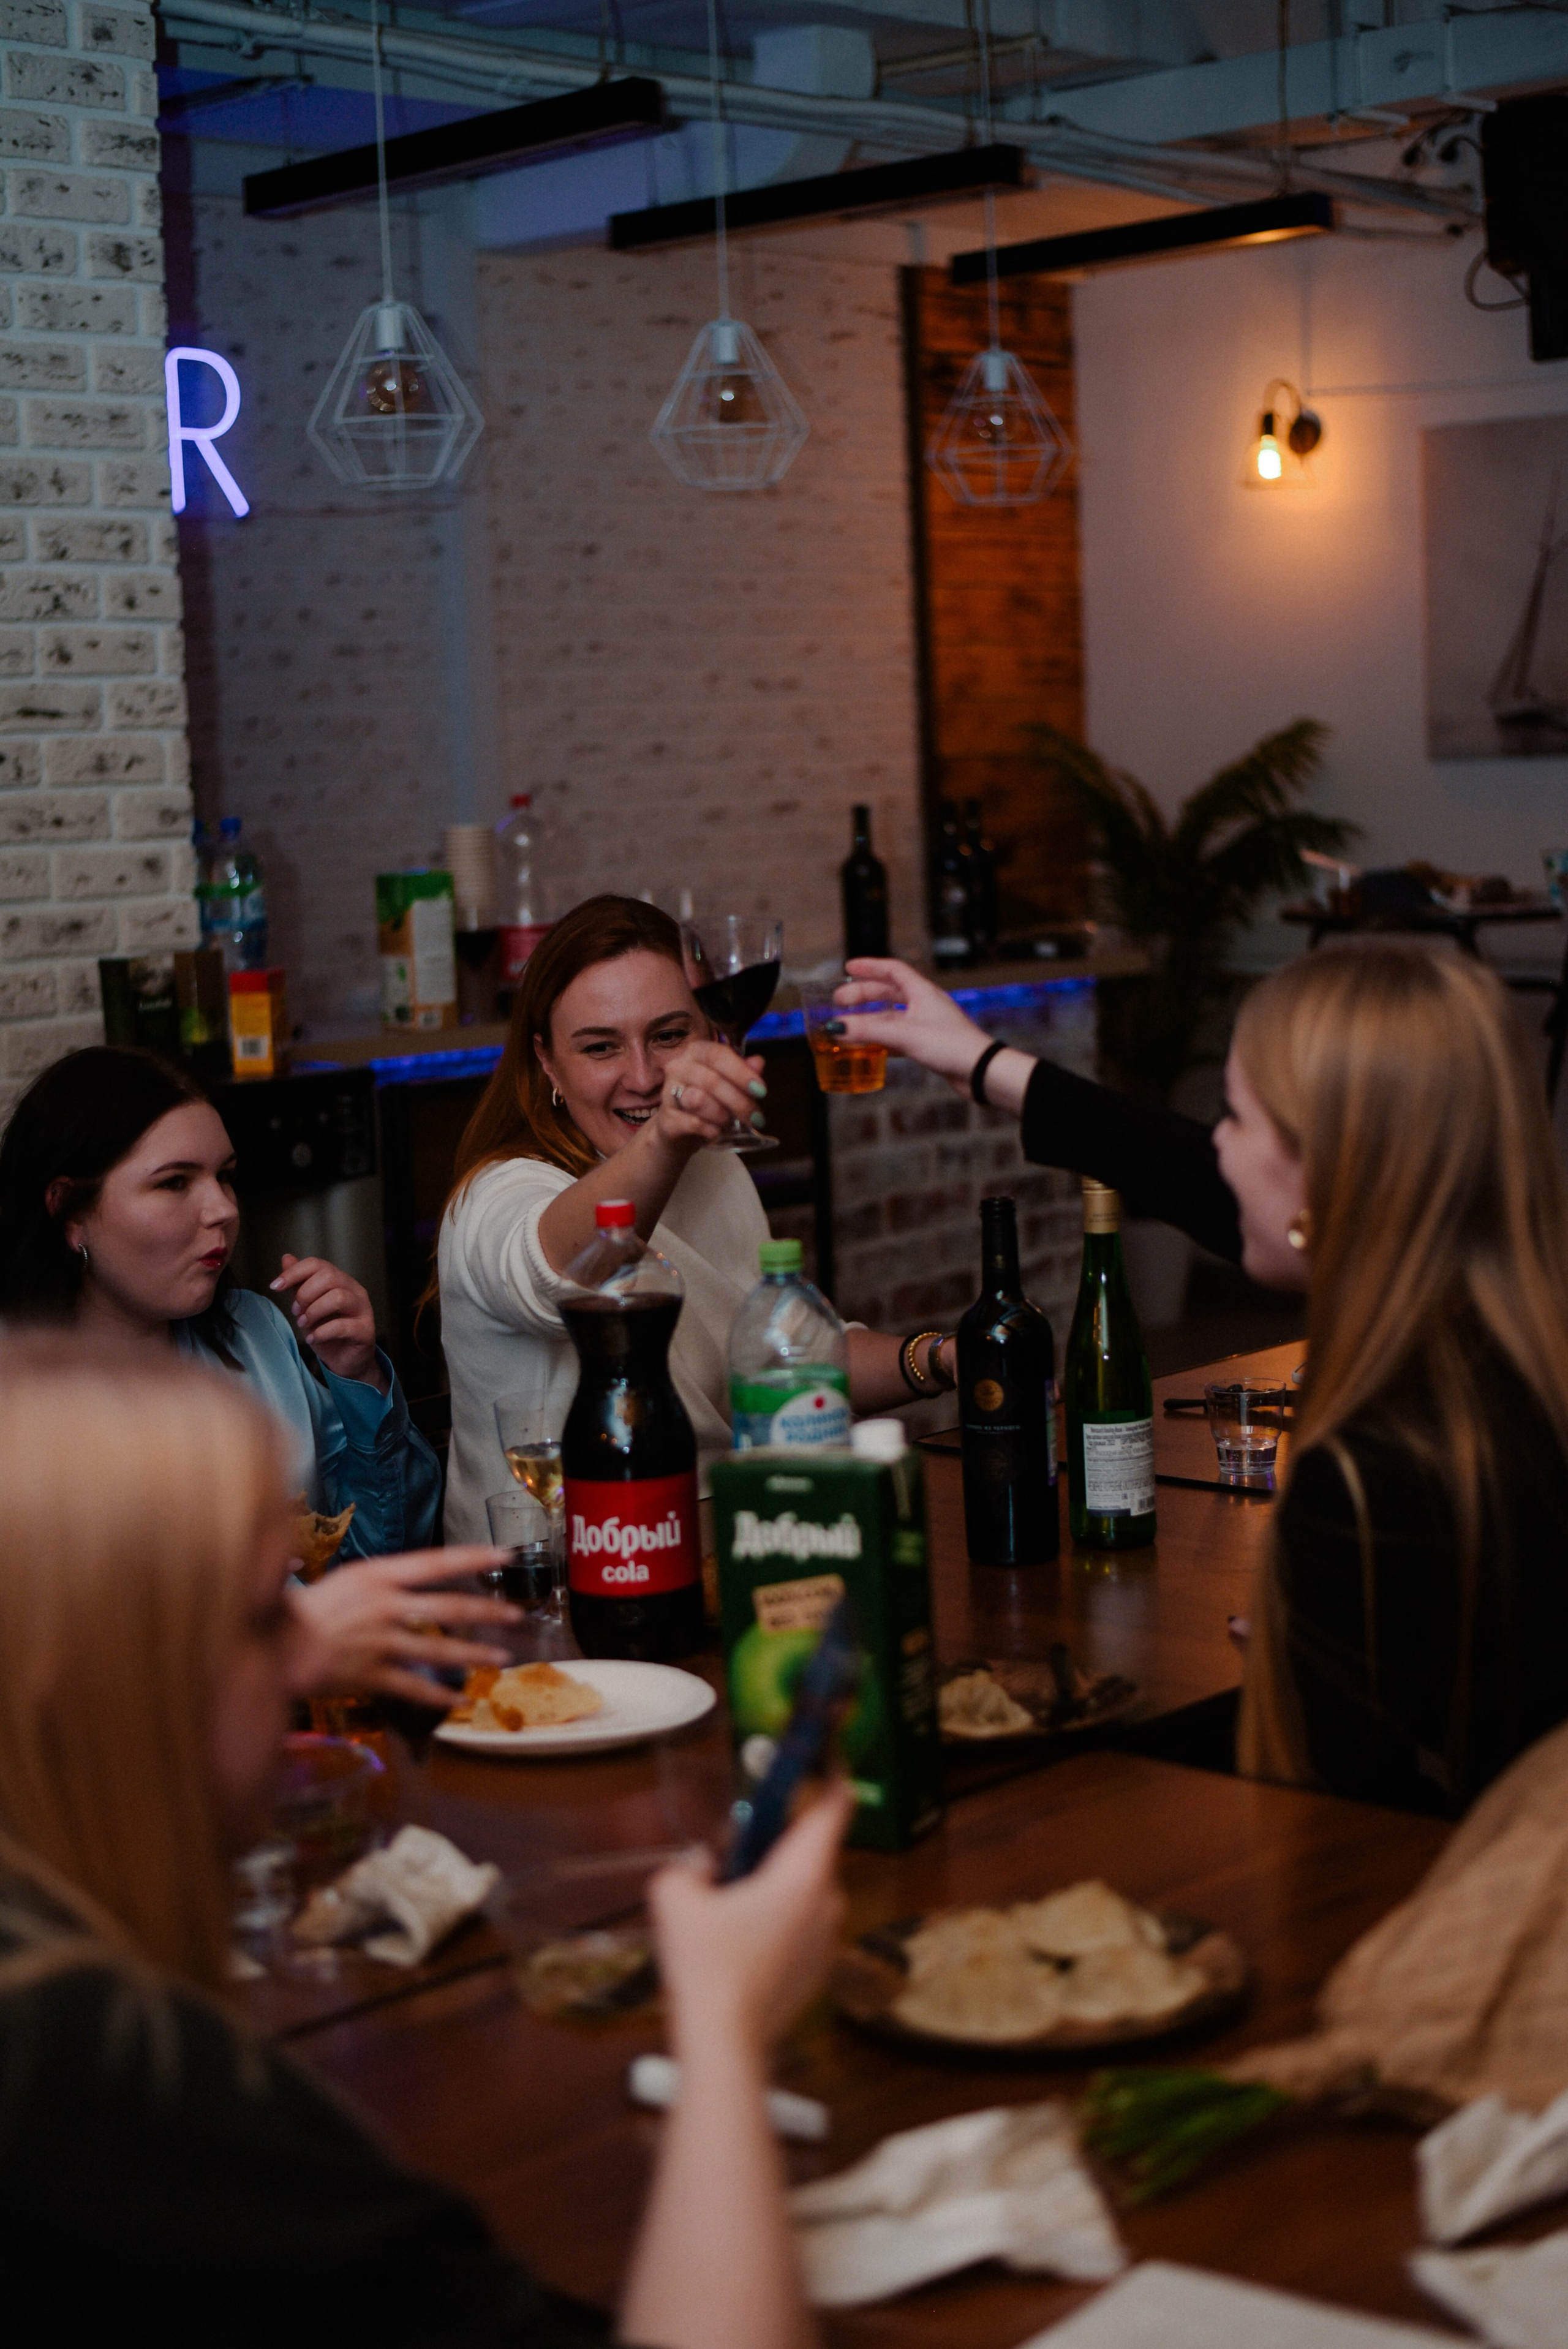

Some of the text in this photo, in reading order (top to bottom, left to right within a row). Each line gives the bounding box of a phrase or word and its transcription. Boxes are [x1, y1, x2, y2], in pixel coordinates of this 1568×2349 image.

[164, 347, 250, 518] R
[572, 1510, 681, 1559] Добрый
[601, 1560, 649, 1583] cola
